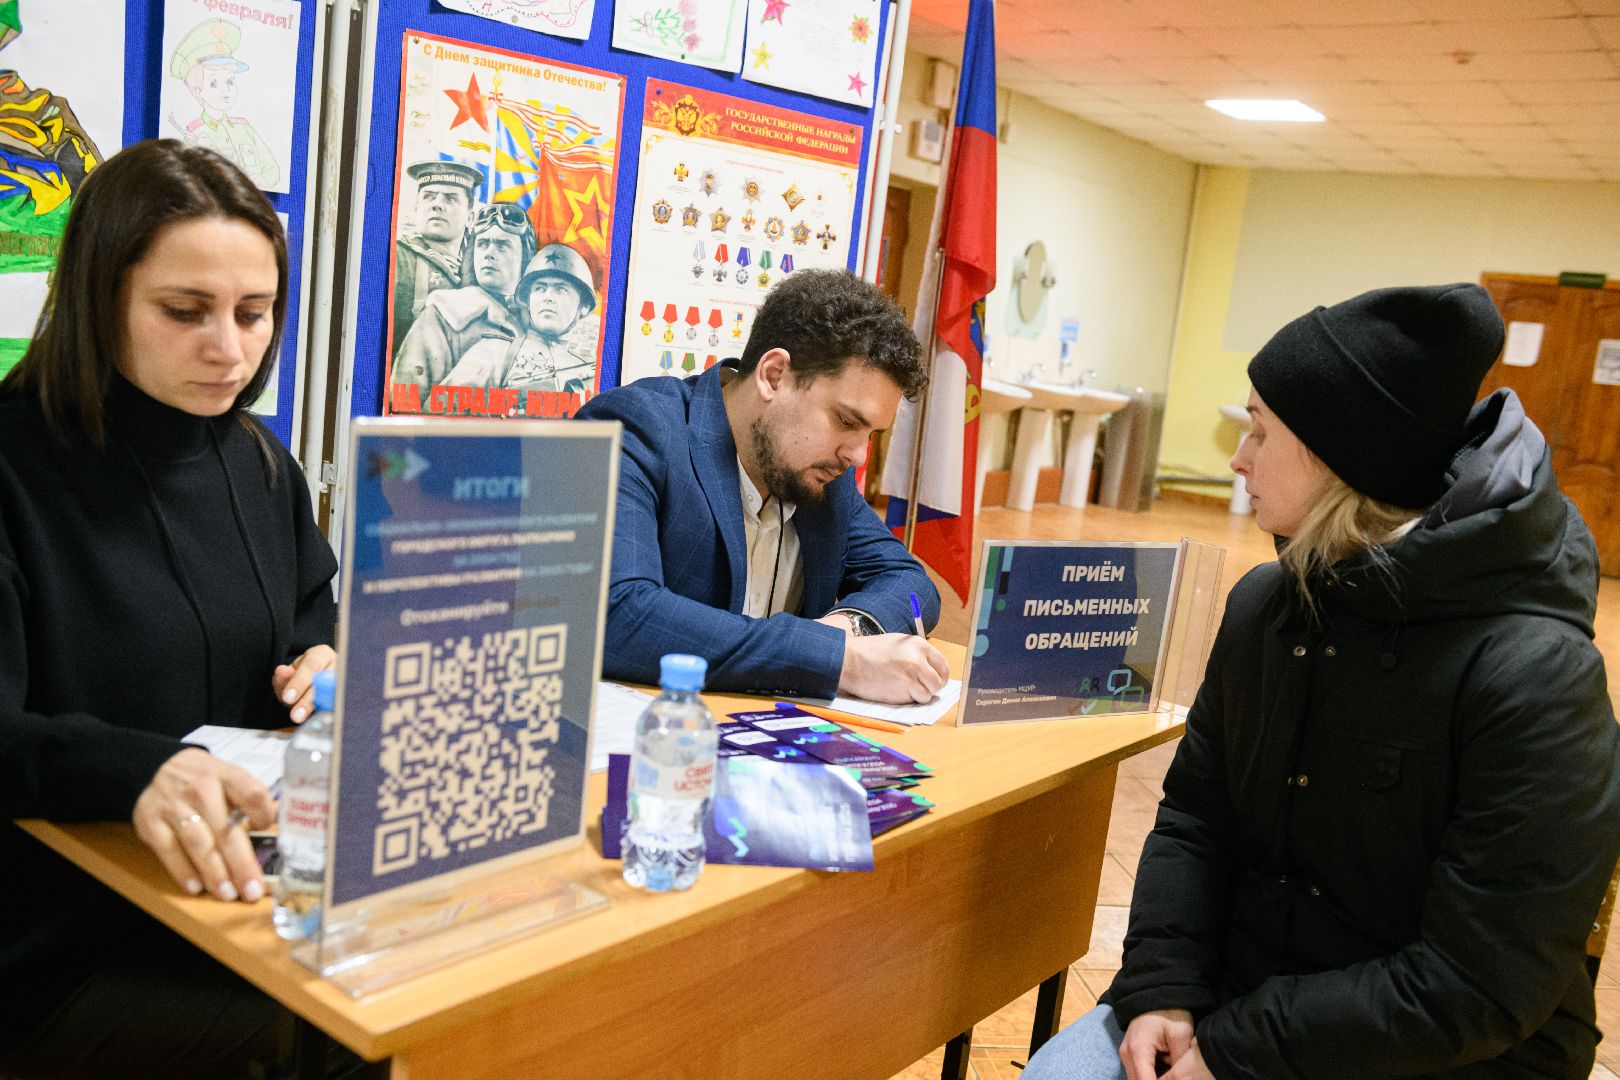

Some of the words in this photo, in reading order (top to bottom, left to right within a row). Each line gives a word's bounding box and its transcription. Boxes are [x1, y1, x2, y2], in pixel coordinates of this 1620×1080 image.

[423, 43, 433, 56] С
[434, 45, 470, 65] Днем
[473, 56, 541, 78] защитника
[543, 68, 607, 92] Отечества!
[725, 107, 815, 134] ГОСУДАРСТВЕННЫЕ
[816, 128, 857, 145] НАГРАДЫ
[730, 121, 794, 143] РОССИЙСКОЙ
[795, 136, 849, 155] ФЕДЕРАЦИИ
[392, 383, 422, 413] НА
[429, 385, 519, 416] СТРАЖЕ
[1062, 561, 1126, 582] ПРИЁМ
[1023, 598, 1150, 617] ПИСЬМЕННЫХ
[1025, 627, 1139, 650] ОБРАЩЕНИЙ
